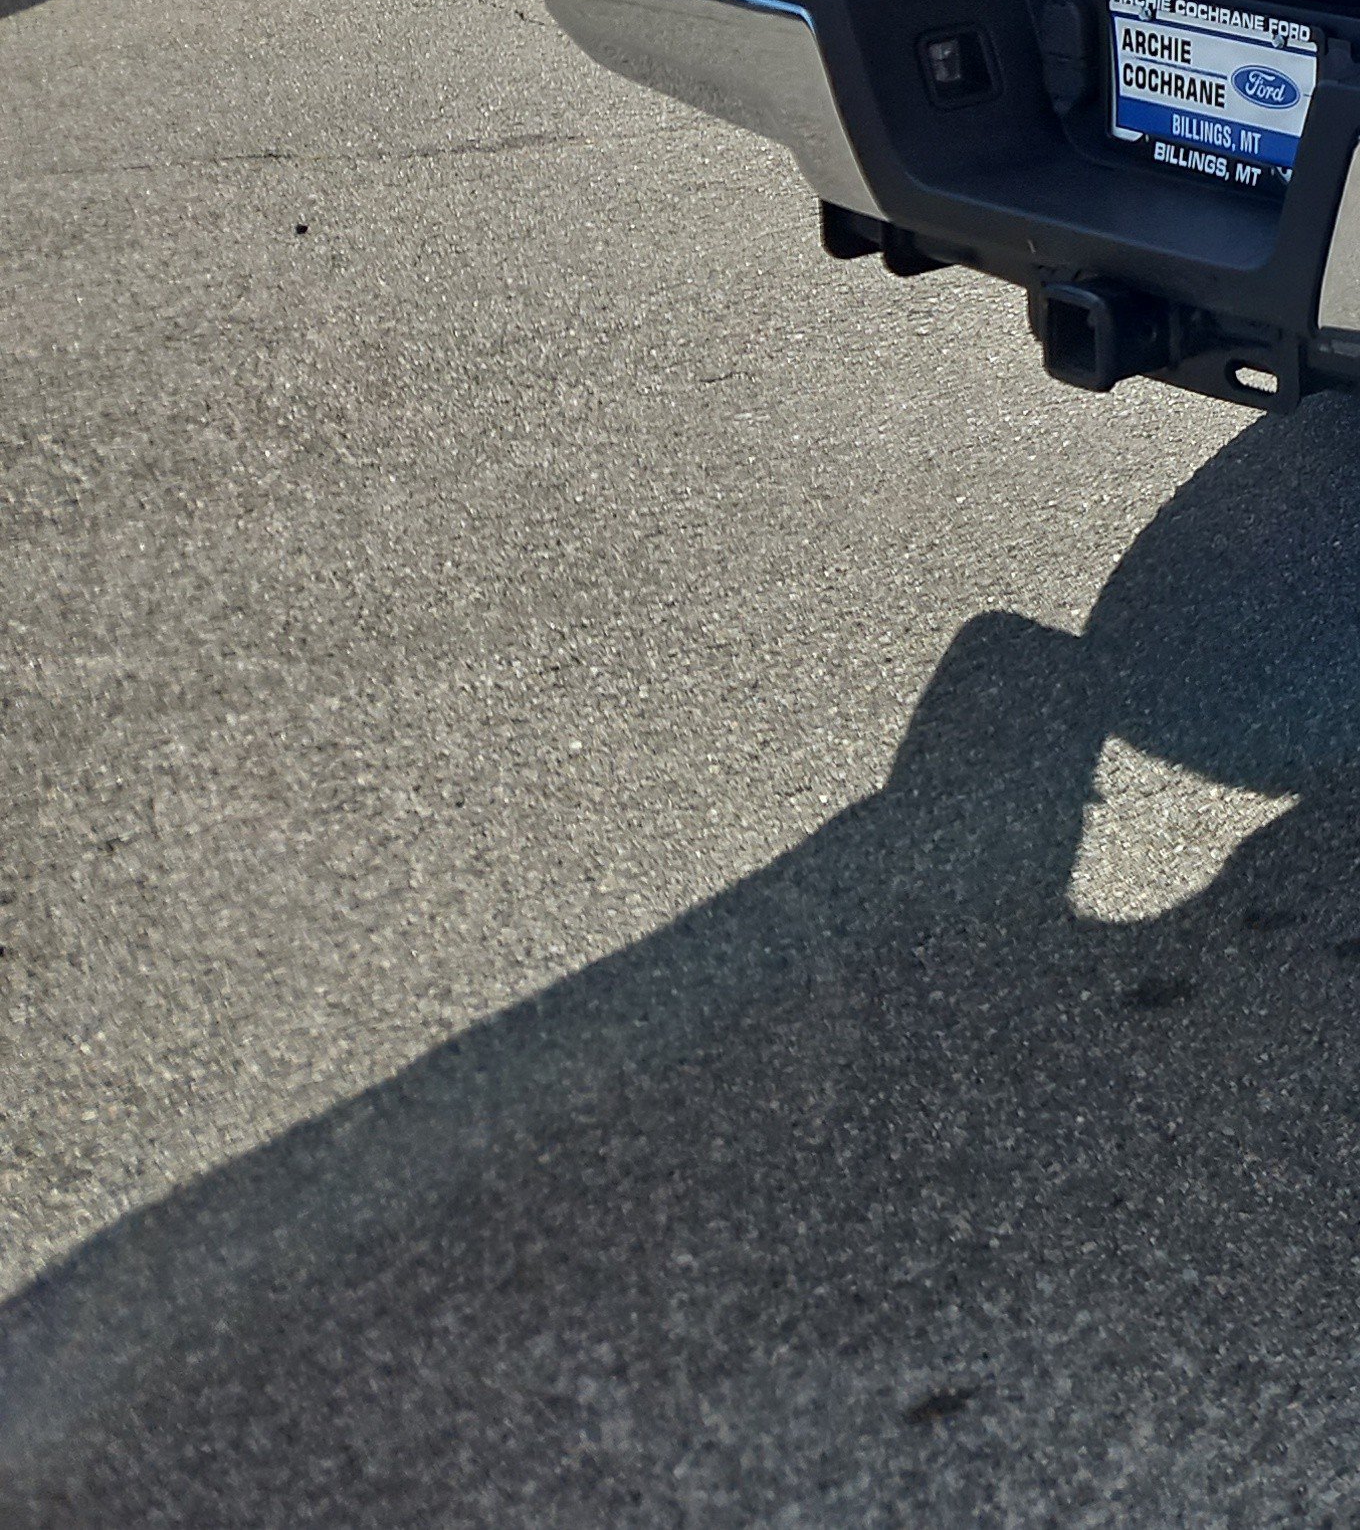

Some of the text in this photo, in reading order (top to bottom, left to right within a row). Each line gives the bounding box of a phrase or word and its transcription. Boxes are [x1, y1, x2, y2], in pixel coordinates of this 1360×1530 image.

[1174, 0, 1265, 31] COCHRANE
[1268, 18, 1311, 42] FORD
[1121, 27, 1192, 65] ARCHIE
[1122, 62, 1226, 109] COCHRANE
[1244, 70, 1285, 103] Ford
[1172, 113, 1262, 155] BILLINGS, MT
[1153, 141, 1262, 187] BILLINGS, MT
